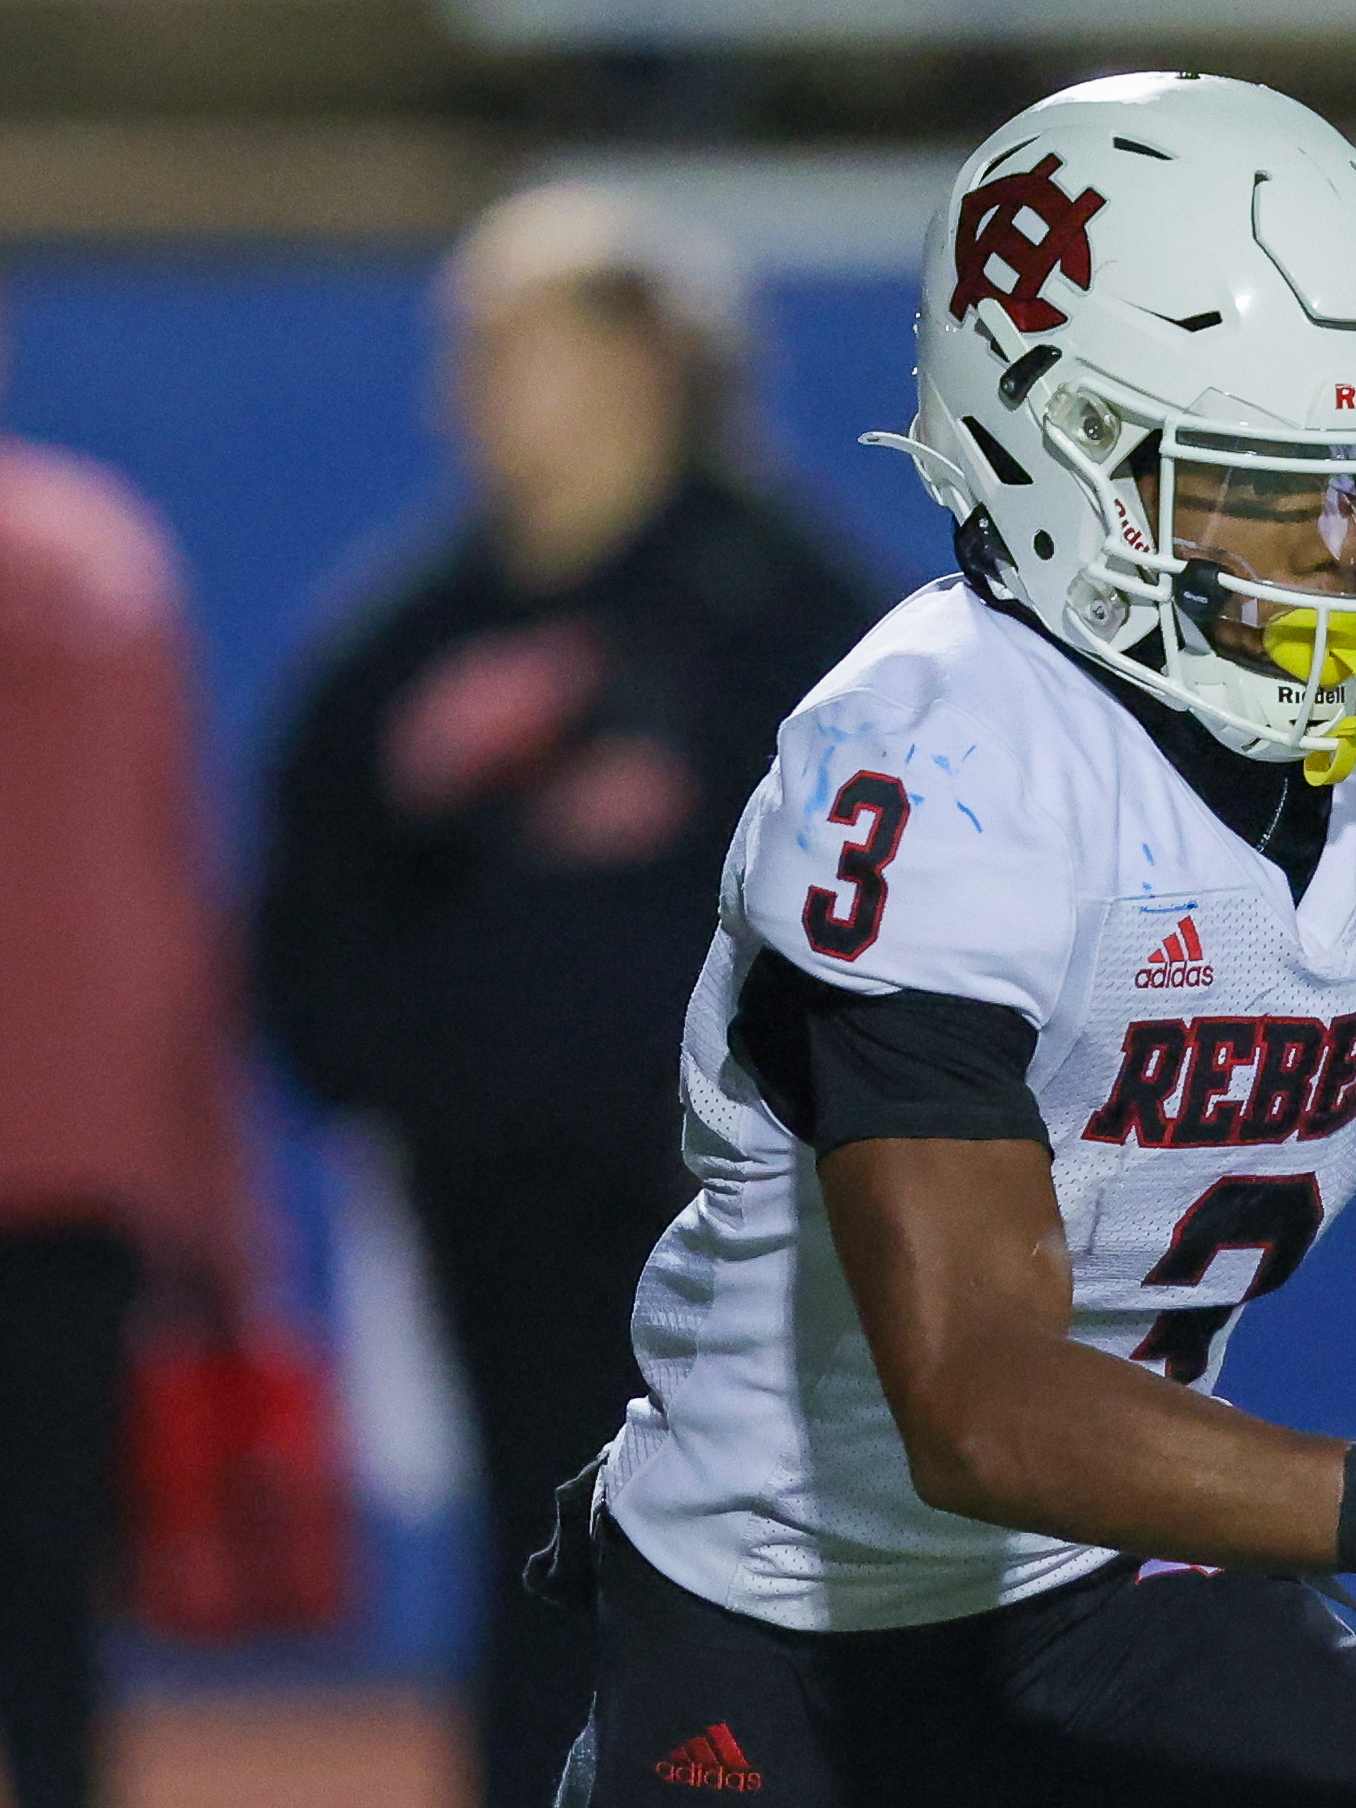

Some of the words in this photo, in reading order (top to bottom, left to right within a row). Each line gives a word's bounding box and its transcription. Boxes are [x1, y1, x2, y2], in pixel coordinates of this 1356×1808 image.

[802, 769, 910, 962] 3
[1134, 960, 1214, 988] adidas
[655, 1760, 763, 1792] adidas
